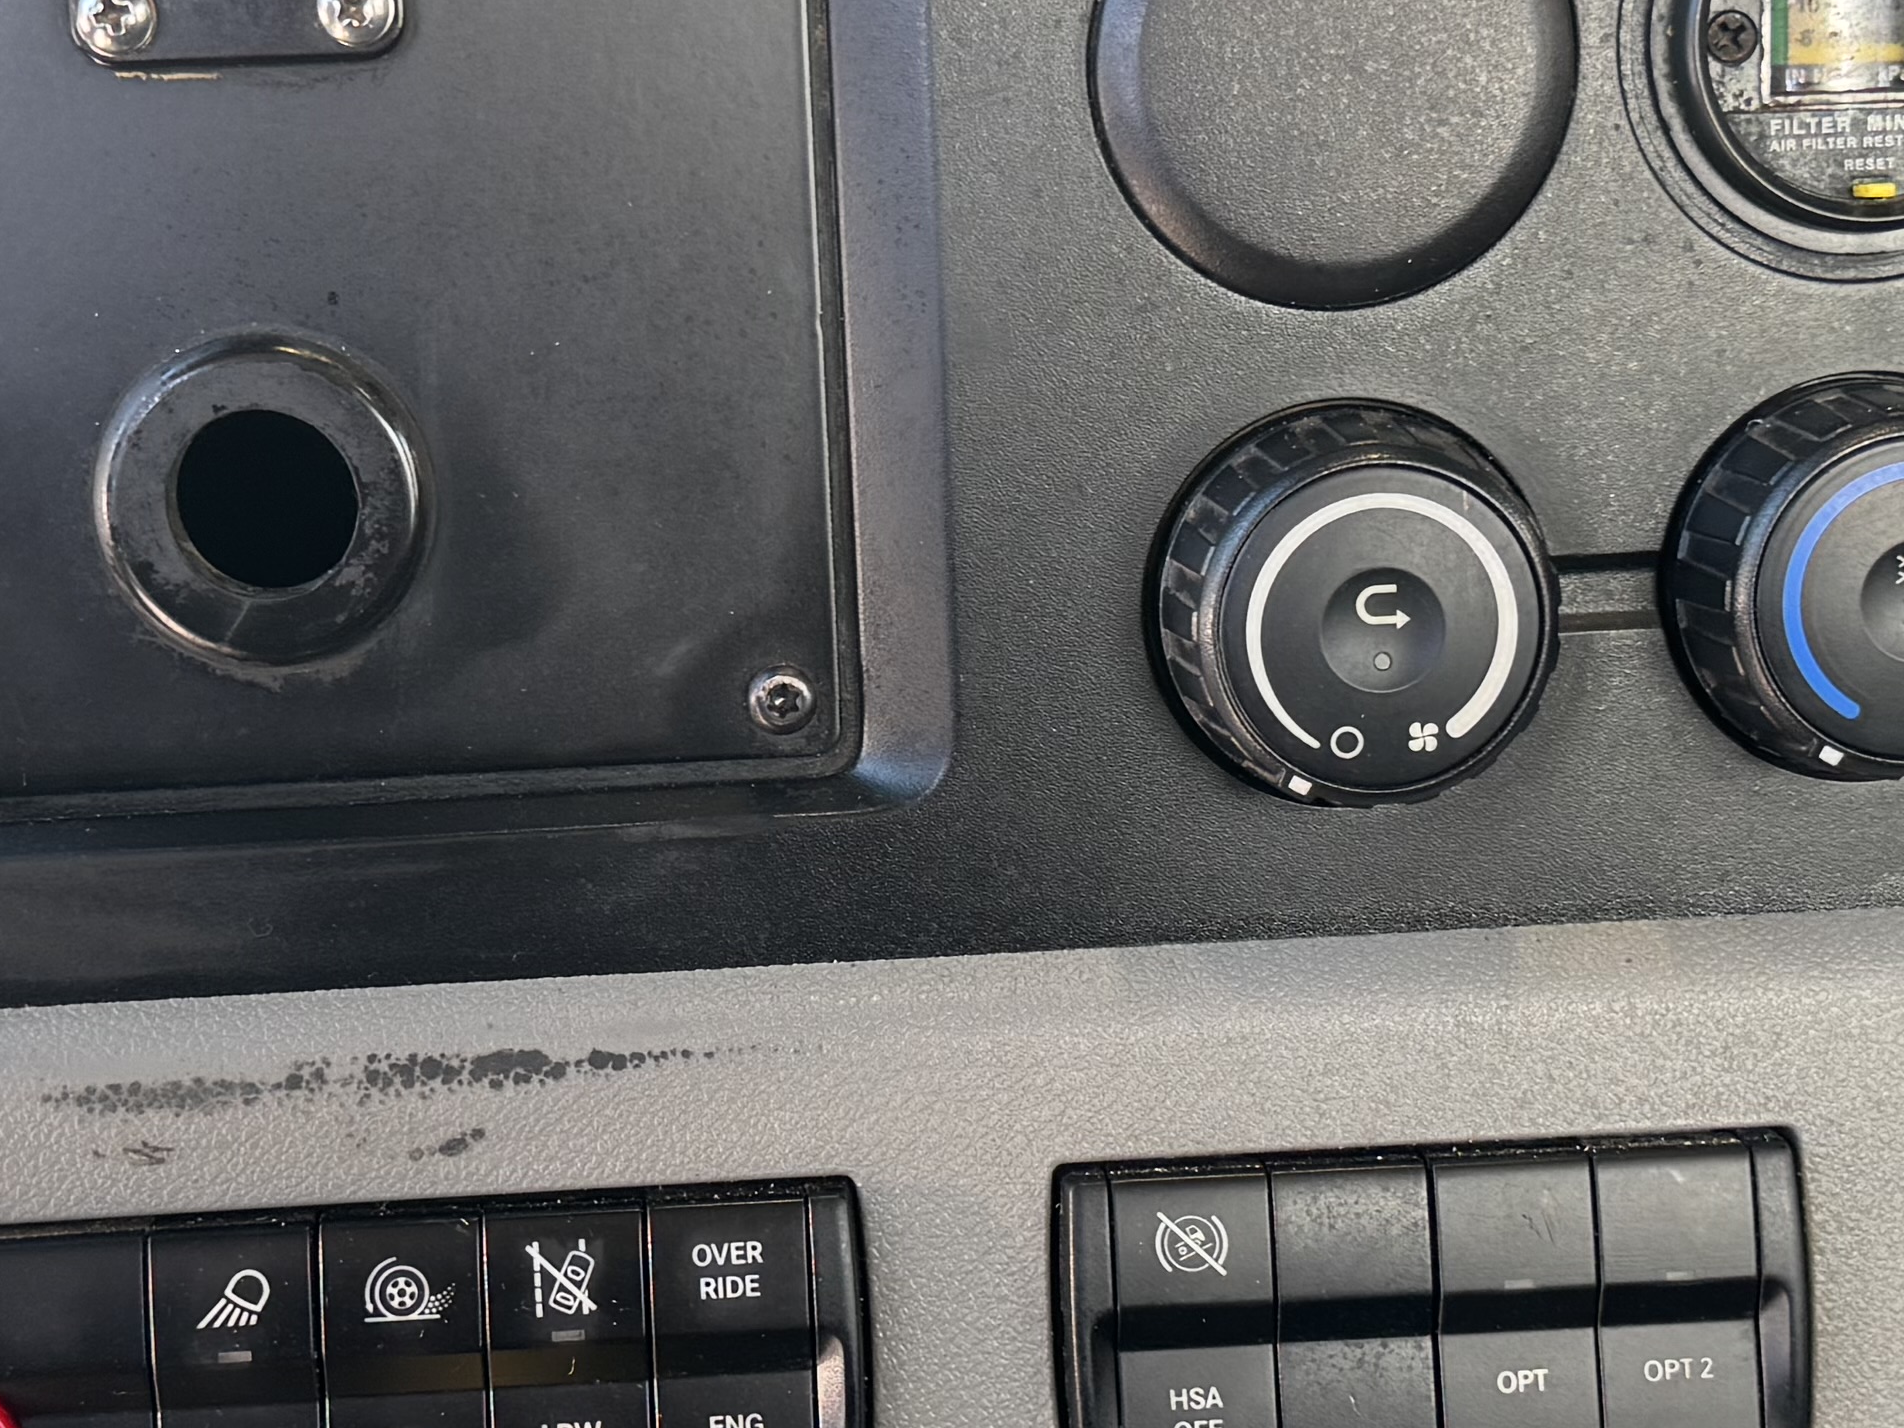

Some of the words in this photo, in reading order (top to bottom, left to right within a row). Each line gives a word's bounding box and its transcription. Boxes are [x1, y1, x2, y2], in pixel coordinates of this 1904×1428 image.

[1770, 116, 1851, 136] FILTER
[1769, 136, 1797, 153] AIR
[1802, 135, 1858, 150] FILTER
[1844, 157, 1895, 171] RESET
[691, 1240, 764, 1269] OVER
[699, 1274, 761, 1301] RIDE
[1497, 1368, 1549, 1395] OPT
[1643, 1360, 1695, 1383] OPT
[1701, 1358, 1714, 1380] 2
[1169, 1386, 1224, 1413] HSA
